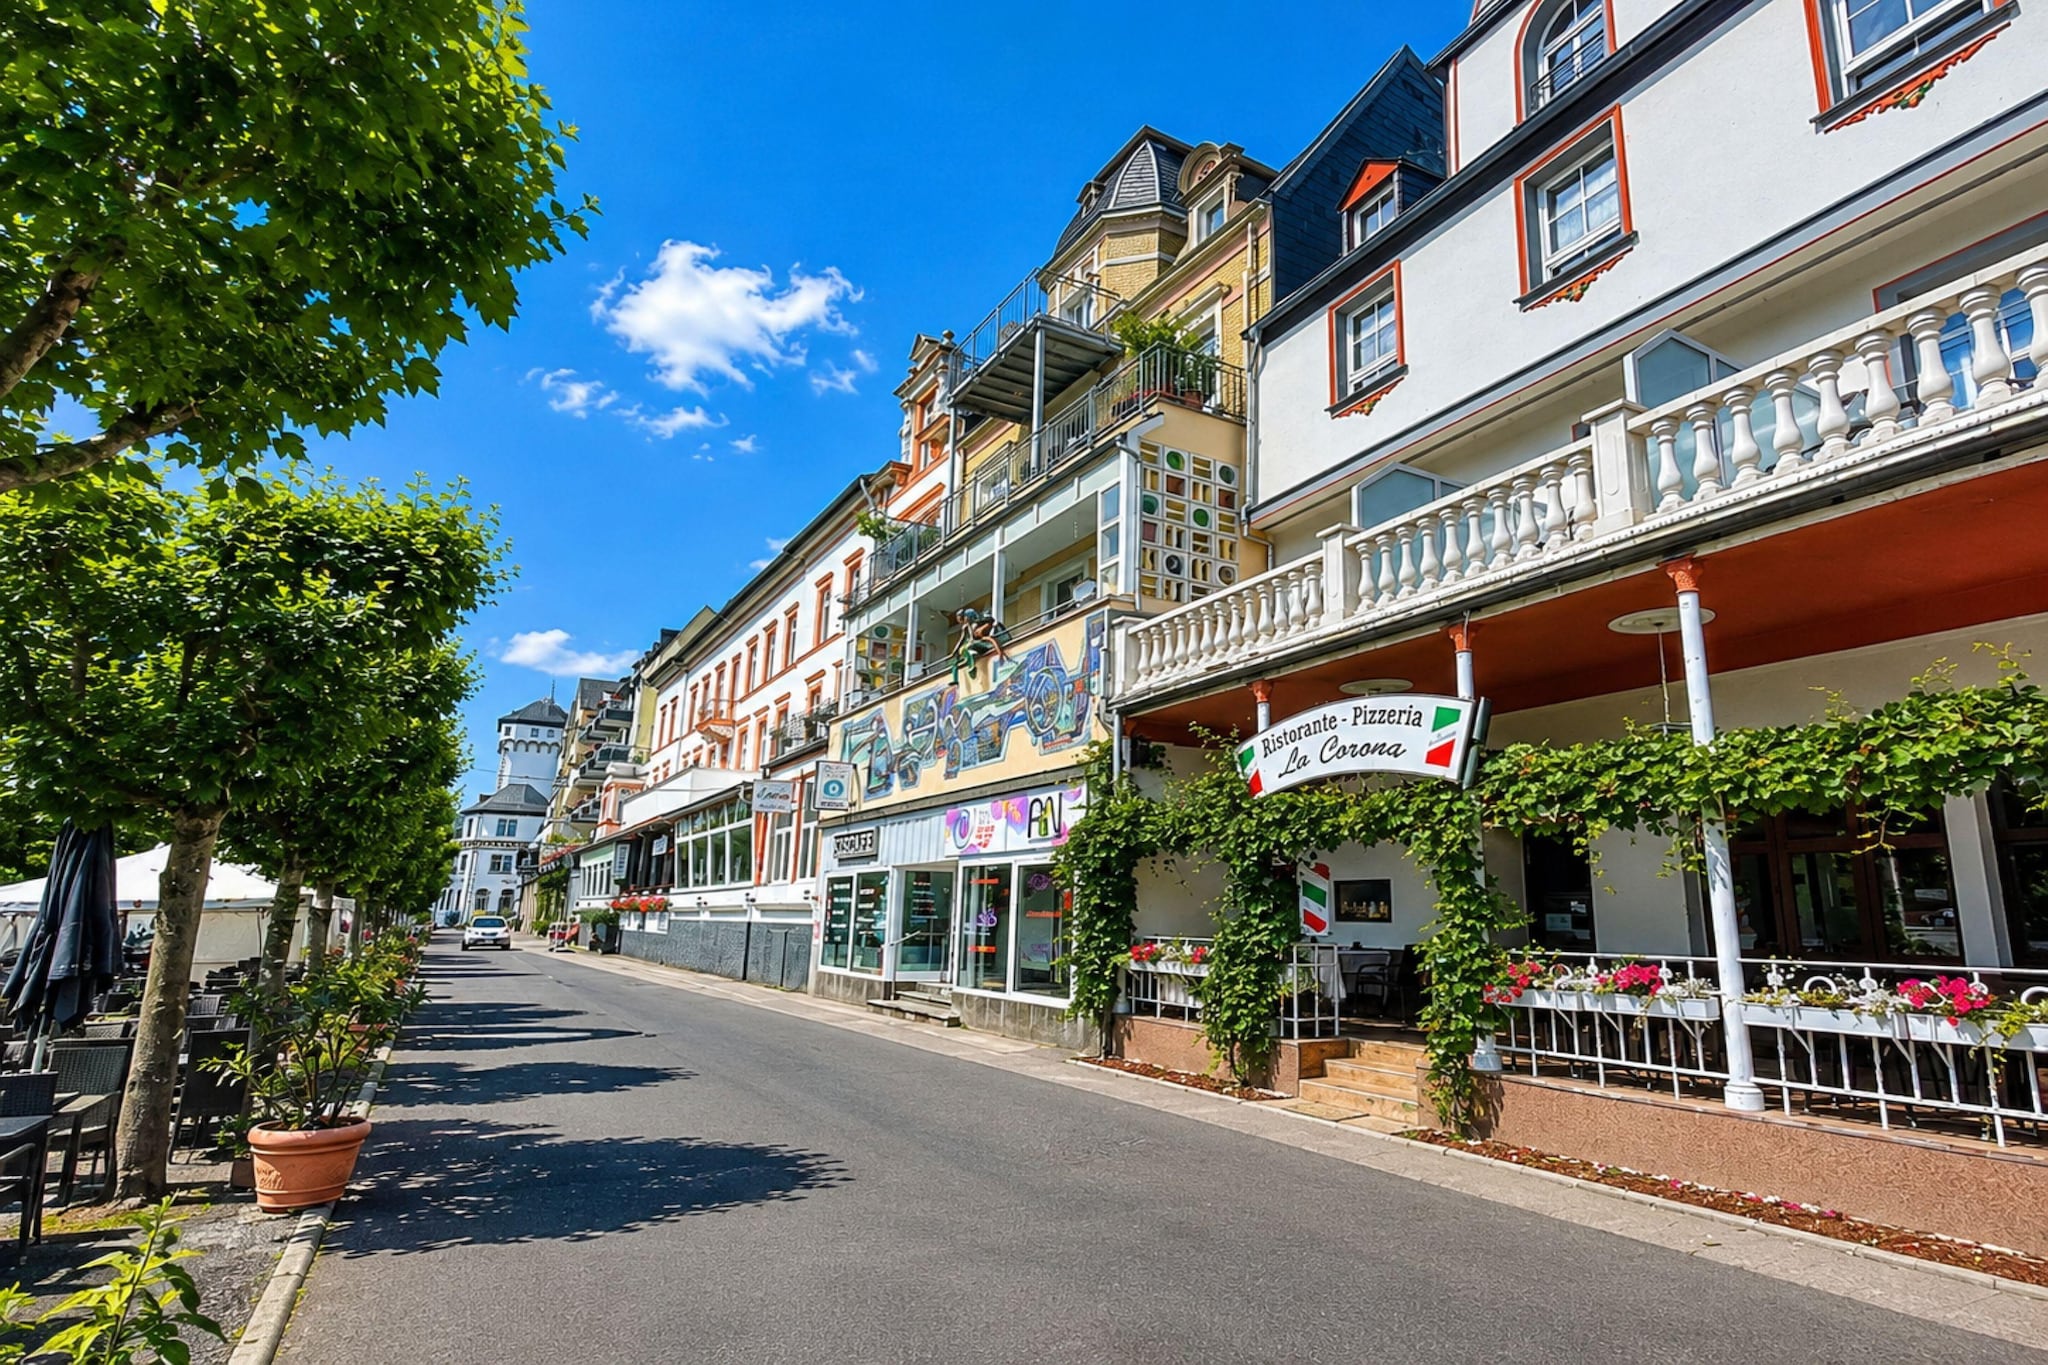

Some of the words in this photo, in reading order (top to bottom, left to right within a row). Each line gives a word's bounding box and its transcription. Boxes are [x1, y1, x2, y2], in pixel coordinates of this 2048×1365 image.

[1261, 715, 1338, 758] Ristorante
[1351, 704, 1422, 727] Pizzeria
[1278, 747, 1310, 778] La
[1319, 735, 1406, 763] Corona
